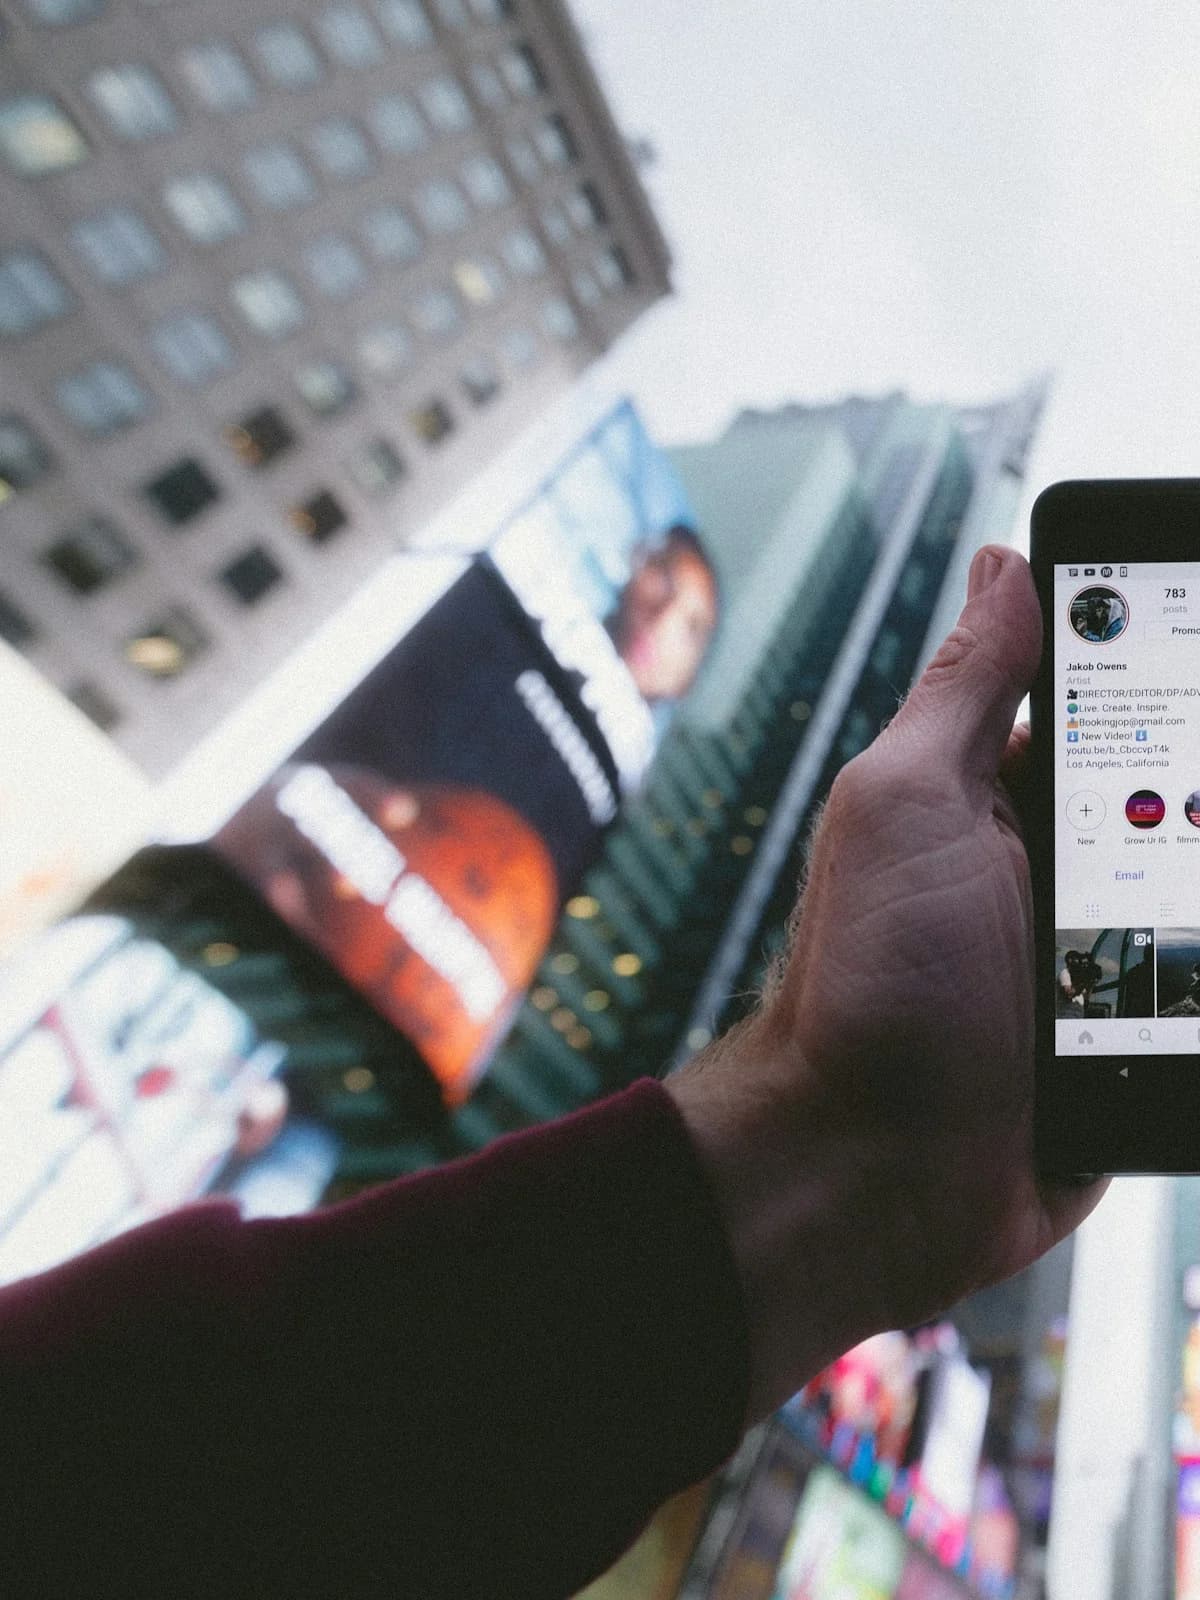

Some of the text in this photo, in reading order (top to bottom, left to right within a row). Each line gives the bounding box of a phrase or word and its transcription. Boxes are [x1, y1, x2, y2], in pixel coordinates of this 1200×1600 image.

[1164, 588, 1186, 599] 783
[1162, 605, 1188, 614] posts
[1066, 662, 1128, 672] Jakob Owens
[1065, 676, 1091, 686] Artist
[1078, 702, 1170, 714] Live. Create. Inspire.
[1078, 716, 1187, 729] Bookingjop@gmail.com
[1081, 731, 1133, 742] New Video!
[1066, 758, 1170, 770] Los Angeles, California
[1077, 837, 1096, 846] New
[1124, 836, 1167, 846] Grow Ur IG
[1114, 870, 1144, 881] Email
